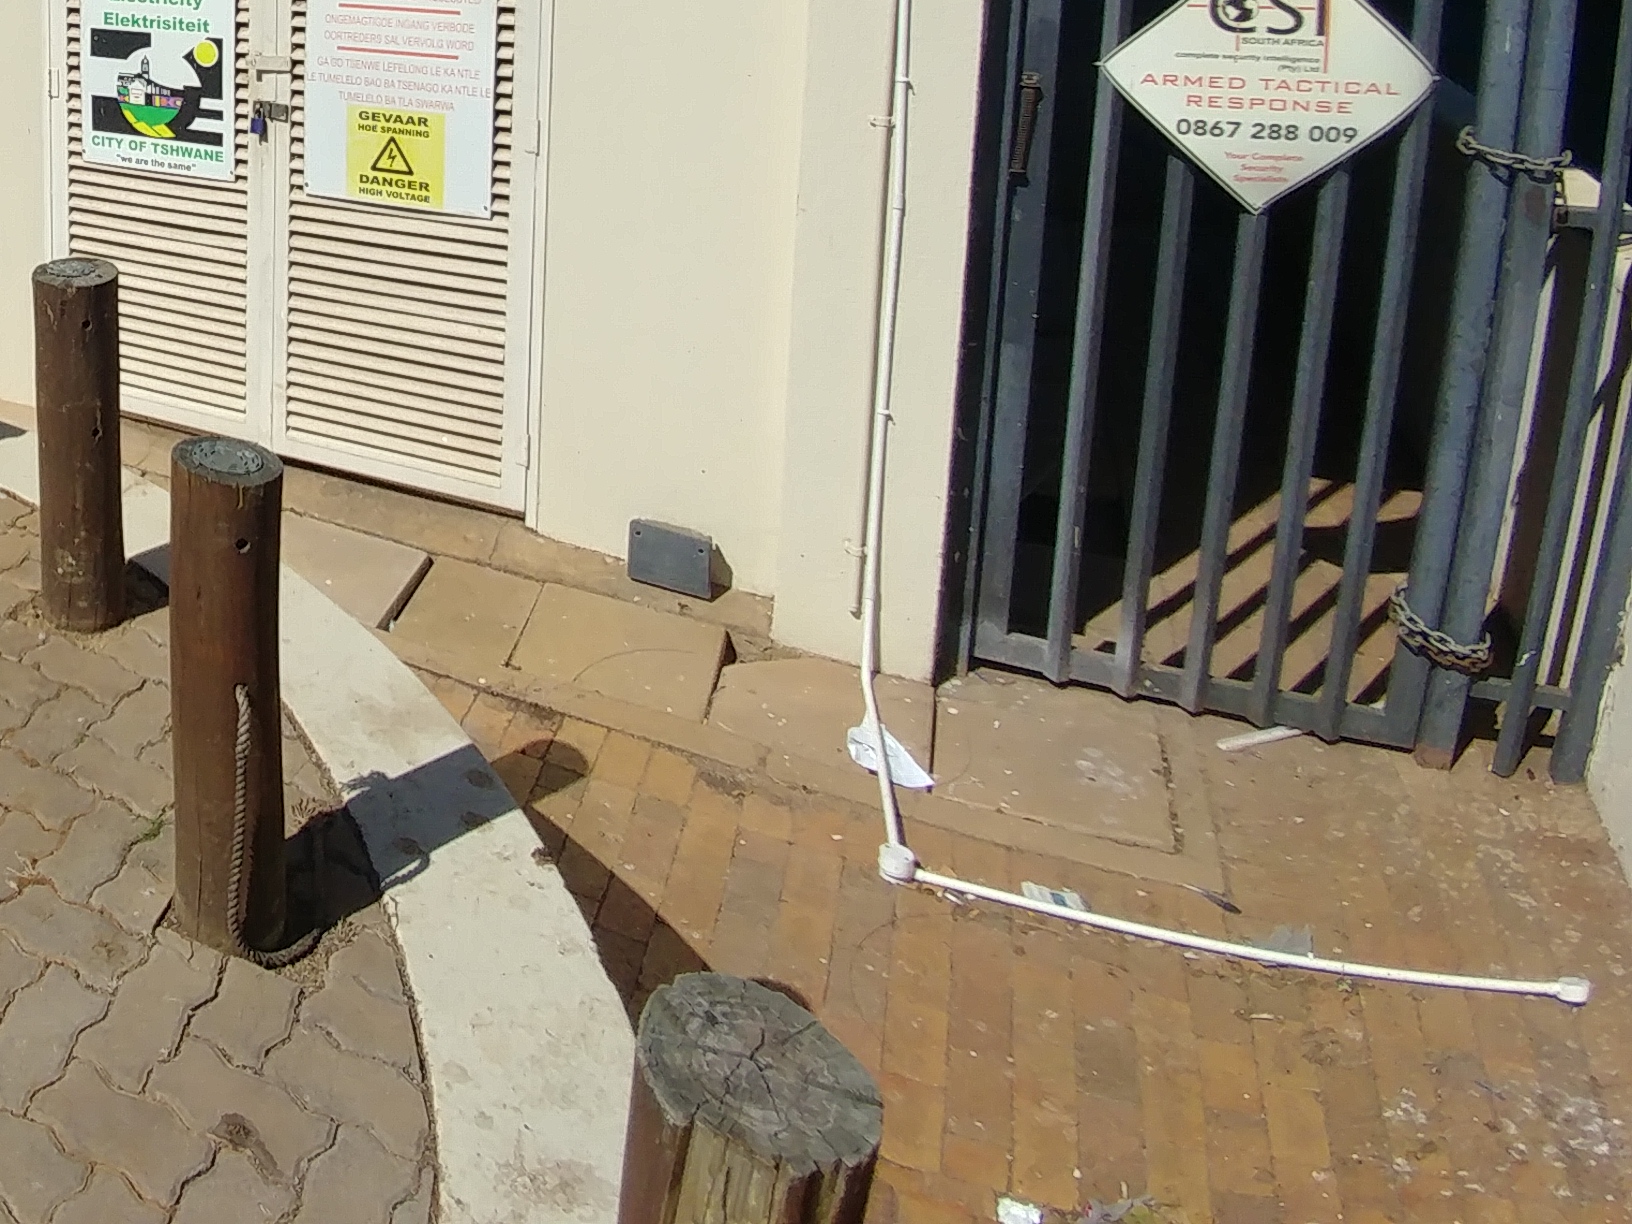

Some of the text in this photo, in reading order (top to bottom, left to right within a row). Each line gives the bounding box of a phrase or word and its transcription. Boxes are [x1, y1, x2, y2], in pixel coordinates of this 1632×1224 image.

[103, 11, 211, 33] Elektrisiteit
[384, 34, 400, 45] SAL
[446, 40, 474, 51] WORD
[1241, 37, 1325, 47] SOUTH AFRICA
[317, 56, 329, 66] GA
[430, 65, 441, 76] LE
[443, 67, 456, 78] KA
[457, 69, 481, 80] NTLE
[307, 71, 317, 81] LE
[384, 79, 396, 89] BA
[440, 83, 453, 94] KA
[455, 85, 478, 97] NTLE
[480, 87, 491, 98] LE
[1140, 73, 1400, 96] ARMED TACTICAL
[384, 94, 396, 105] BA
[1186, 95, 1353, 114] RESPONSE
[358, 110, 429, 128] GEVAAR
[380, 125, 430, 139] SPANNING
[1176, 118, 1358, 144] 0867 288 009
[91, 135, 225, 163] CITY OF TSHWANE
[135, 157, 149, 166] are
[151, 159, 165, 168] the
[359, 174, 430, 192] DANGER
[358, 186, 430, 203] HIGH VOLTAGE
